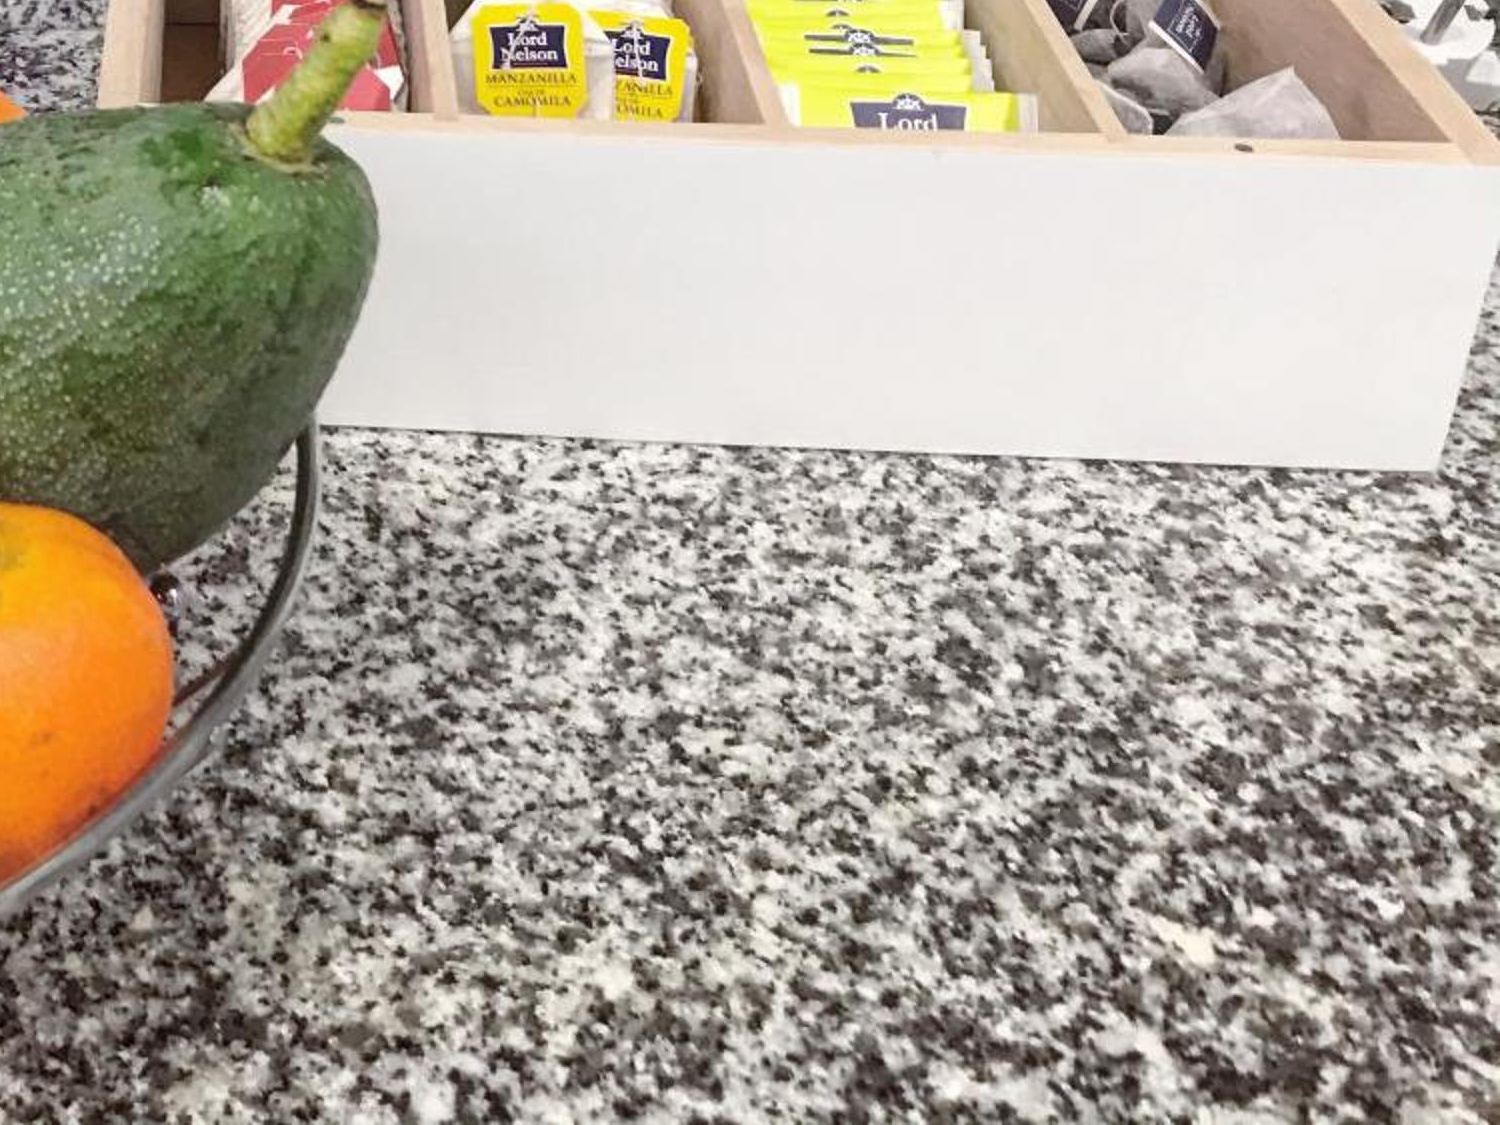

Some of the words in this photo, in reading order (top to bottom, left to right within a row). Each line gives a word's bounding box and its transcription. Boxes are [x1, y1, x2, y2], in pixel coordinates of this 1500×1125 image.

[507, 31, 548, 46] Lord
[501, 46, 559, 61] Nelson
[612, 39, 651, 56] Lord
[614, 55, 658, 72] elson
[485, 72, 578, 85] MANZANILLA
[493, 95, 572, 109] CAMOMILA
[877, 112, 938, 132] Lord
